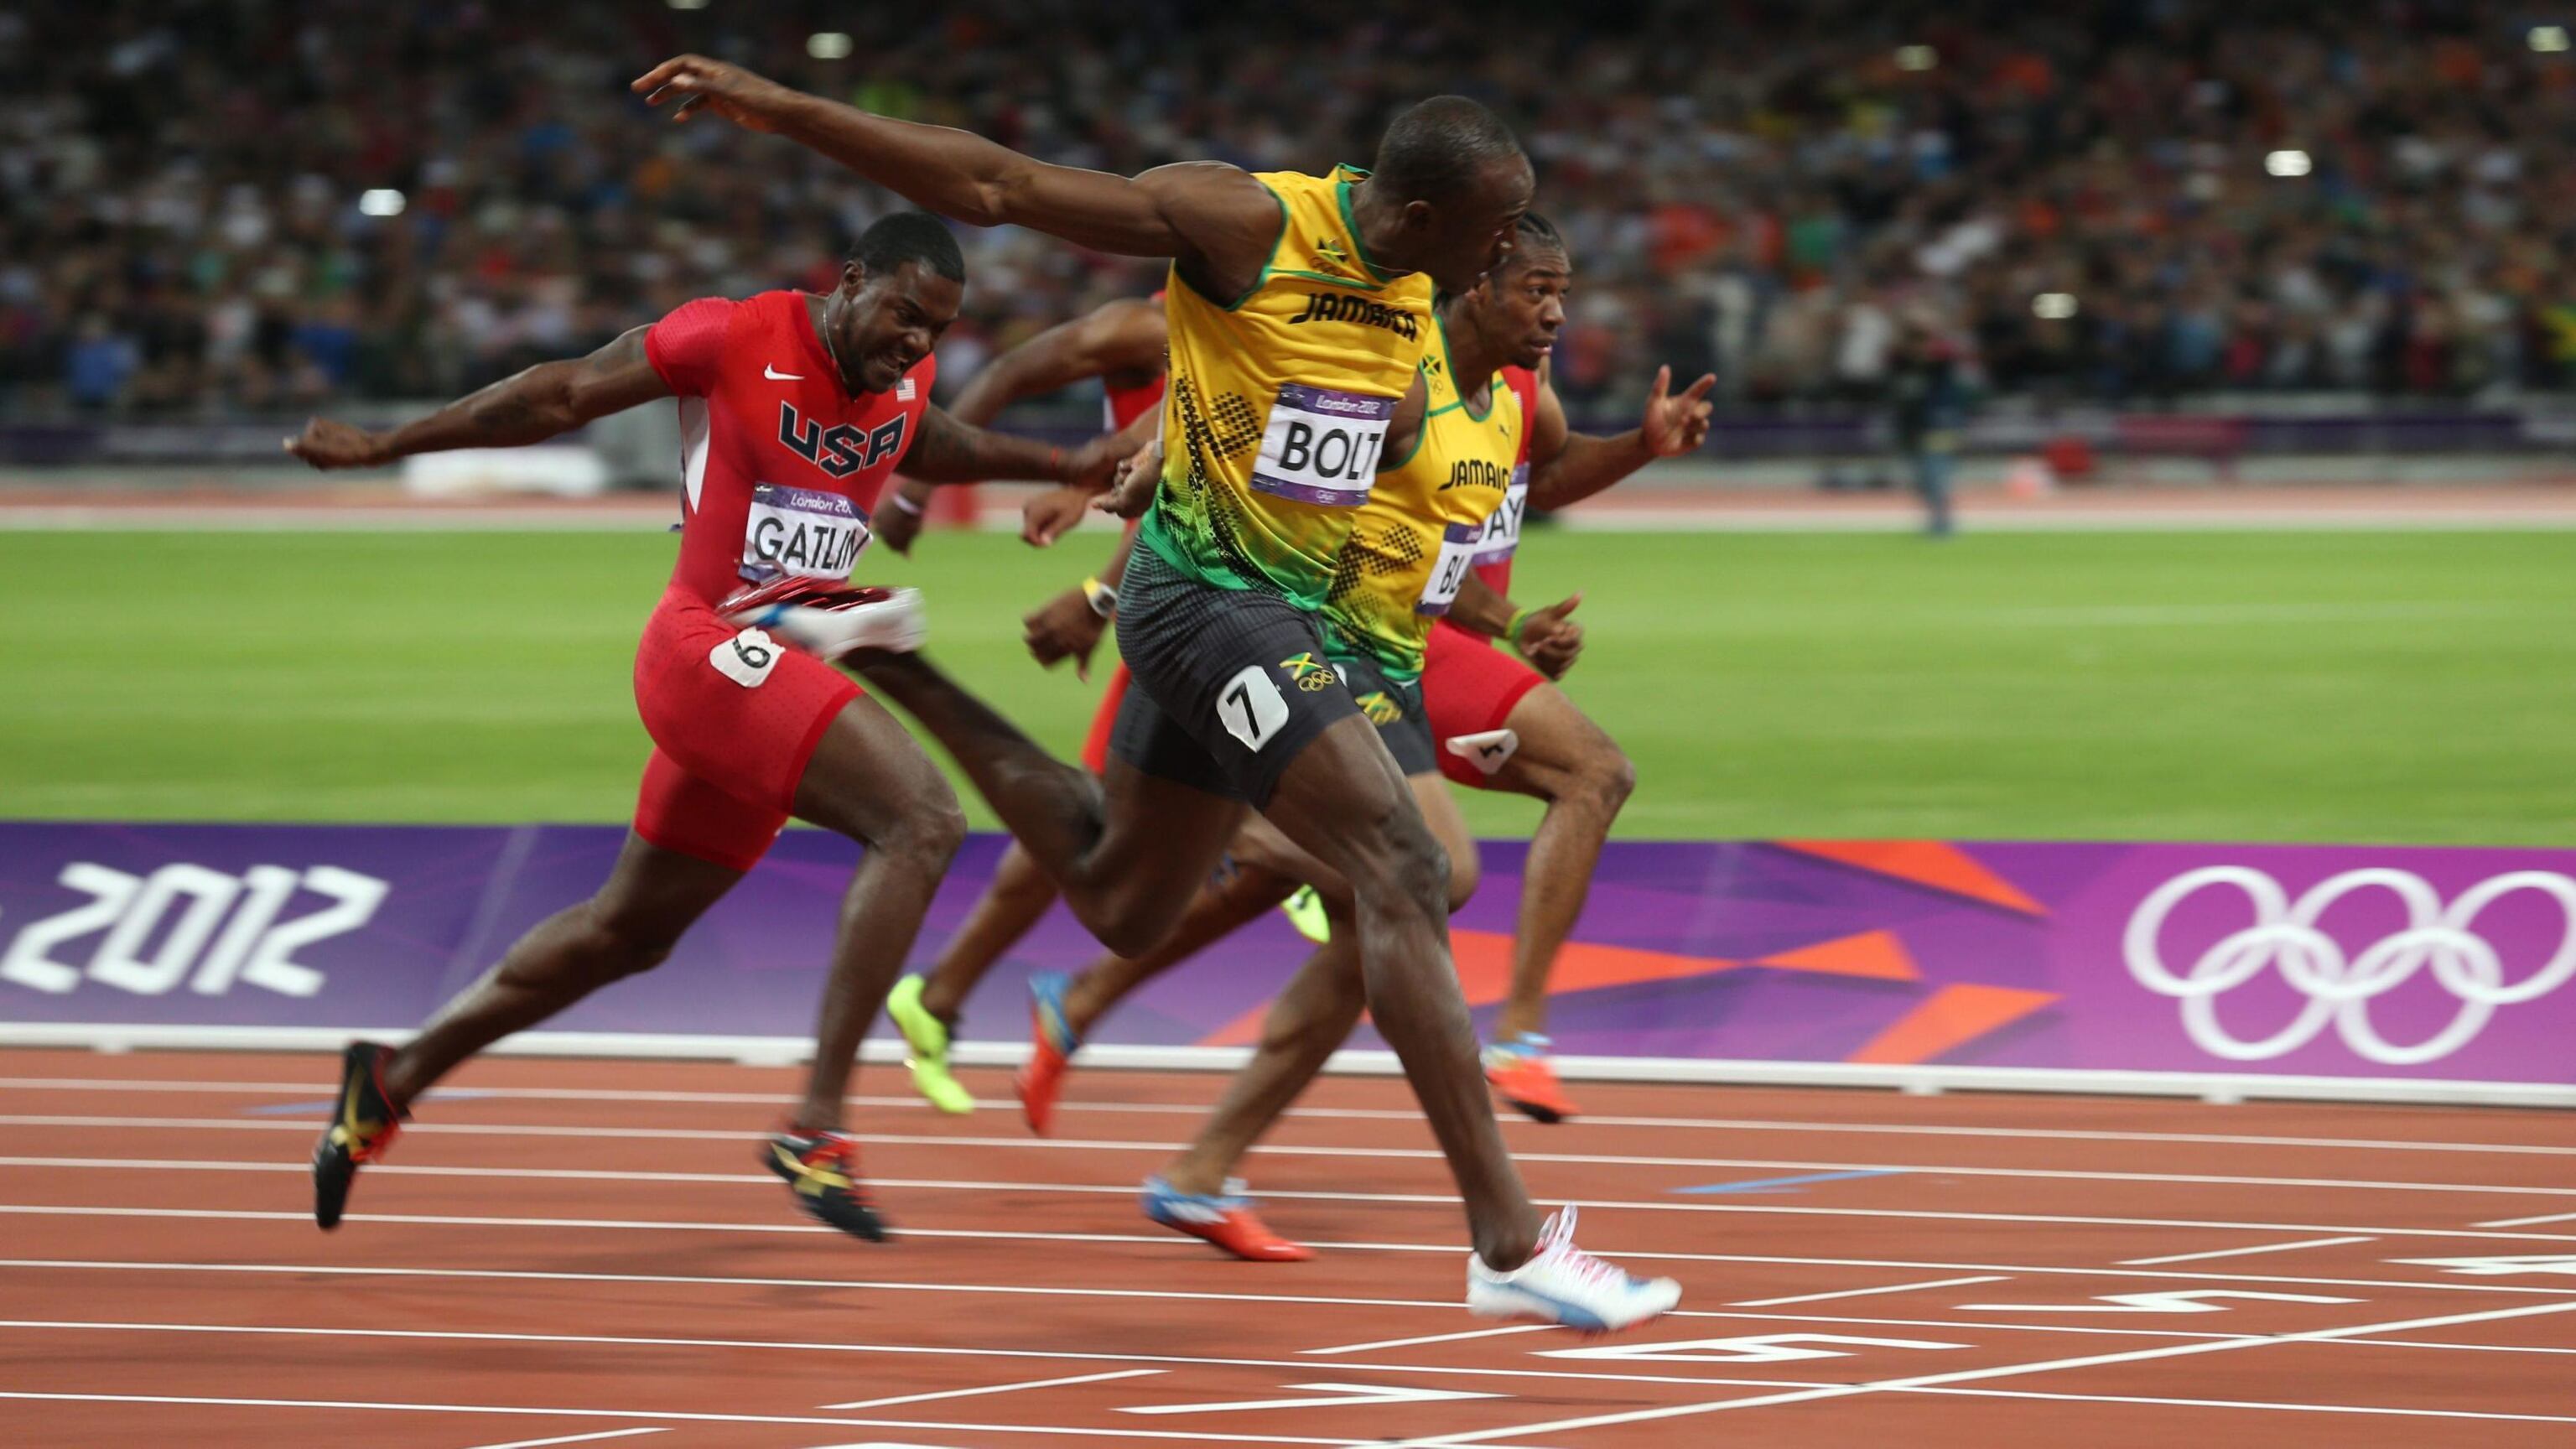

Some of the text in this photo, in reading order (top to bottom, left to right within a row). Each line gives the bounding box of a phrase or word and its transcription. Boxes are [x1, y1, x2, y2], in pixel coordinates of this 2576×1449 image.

[1289, 293, 1417, 343] JAMAICA
[778, 399, 906, 479] USA
[1278, 421, 1382, 480] BOLT
[791, 493, 833, 512] London
[1437, 459, 1510, 496] JAMAIC
[754, 517, 870, 570] GATLIN
[1488, 496, 1525, 540] AY
[1226, 681, 1260, 740] 7
[1, 862, 391, 997] 2012
